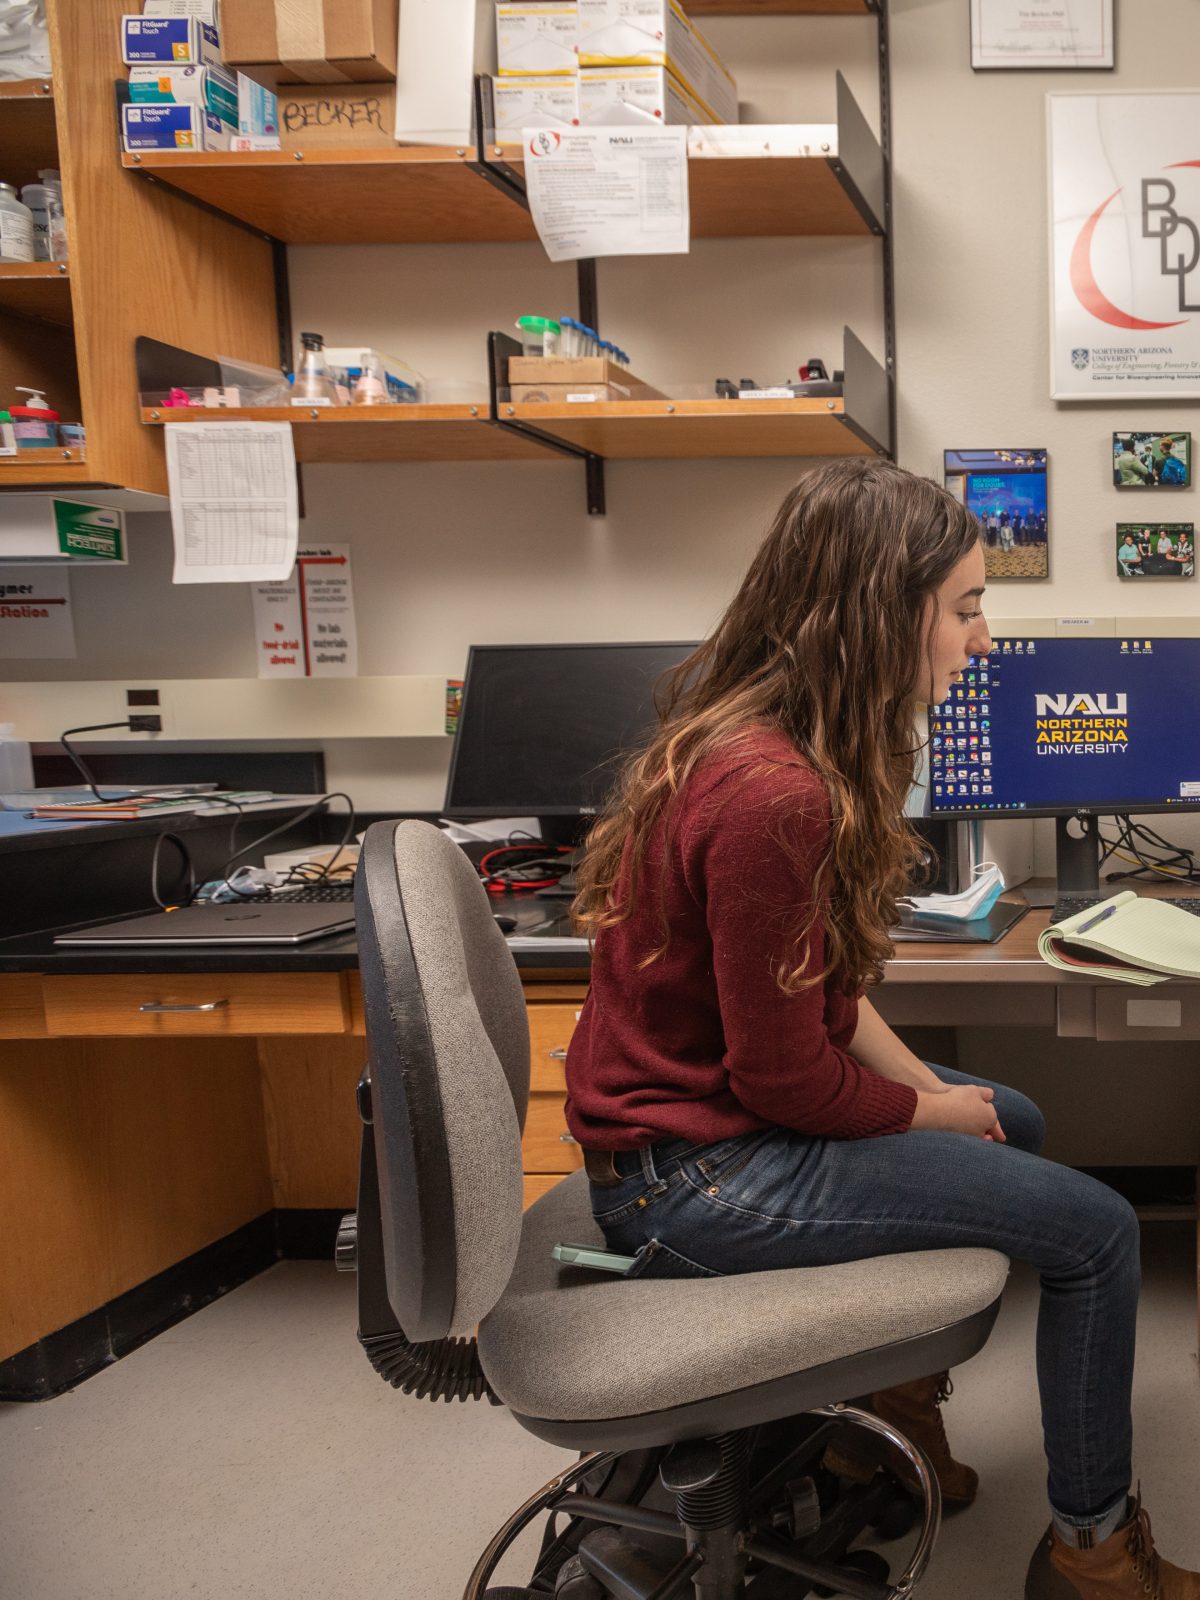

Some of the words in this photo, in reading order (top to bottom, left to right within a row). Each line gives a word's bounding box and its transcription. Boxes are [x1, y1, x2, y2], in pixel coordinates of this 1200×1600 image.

[177, 44, 186, 57] S
[283, 98, 388, 133] BECKER
[180, 131, 189, 144] S
[1092, 362, 1113, 370] College
[0, 606, 49, 618] Station
[1035, 693, 1128, 715] NAU
[1036, 718, 1128, 729] NORTHERN
[1036, 730, 1128, 743] ARIZONA
[1037, 743, 1128, 755] UNIVERSITY
